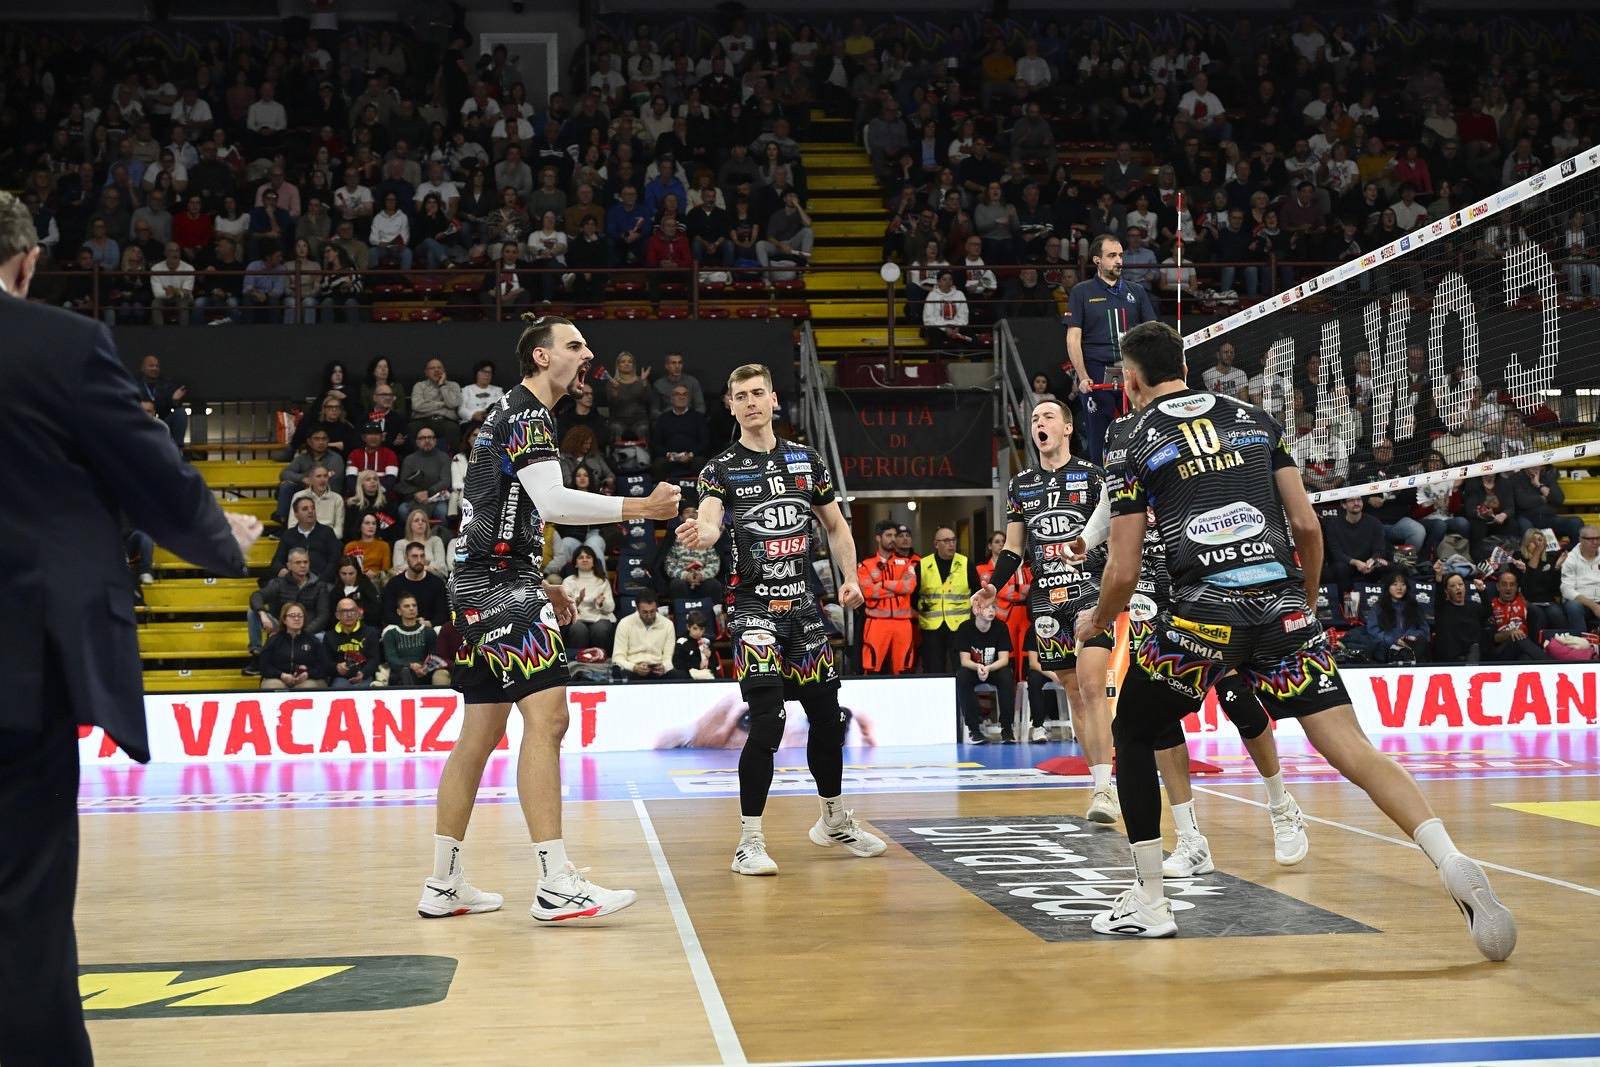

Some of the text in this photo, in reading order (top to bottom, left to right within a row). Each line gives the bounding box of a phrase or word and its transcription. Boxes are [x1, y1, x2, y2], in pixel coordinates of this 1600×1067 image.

[1177, 417, 1220, 457] 10
[843, 456, 955, 478] PERUGIA
[767, 476, 787, 496] 16
[1047, 491, 1061, 508] 17
[503, 482, 520, 540] GRANIERI
[763, 505, 798, 529] SIR
[1040, 515, 1071, 535] SIR
[1189, 511, 1264, 536] VALTIBERINO
[768, 538, 807, 556] SUSA
[1197, 546, 1237, 566] VUS
[1180, 637, 1224, 660] KIMIA
[749, 662, 777, 673] CEA
[172, 695, 508, 757] VACANZ
